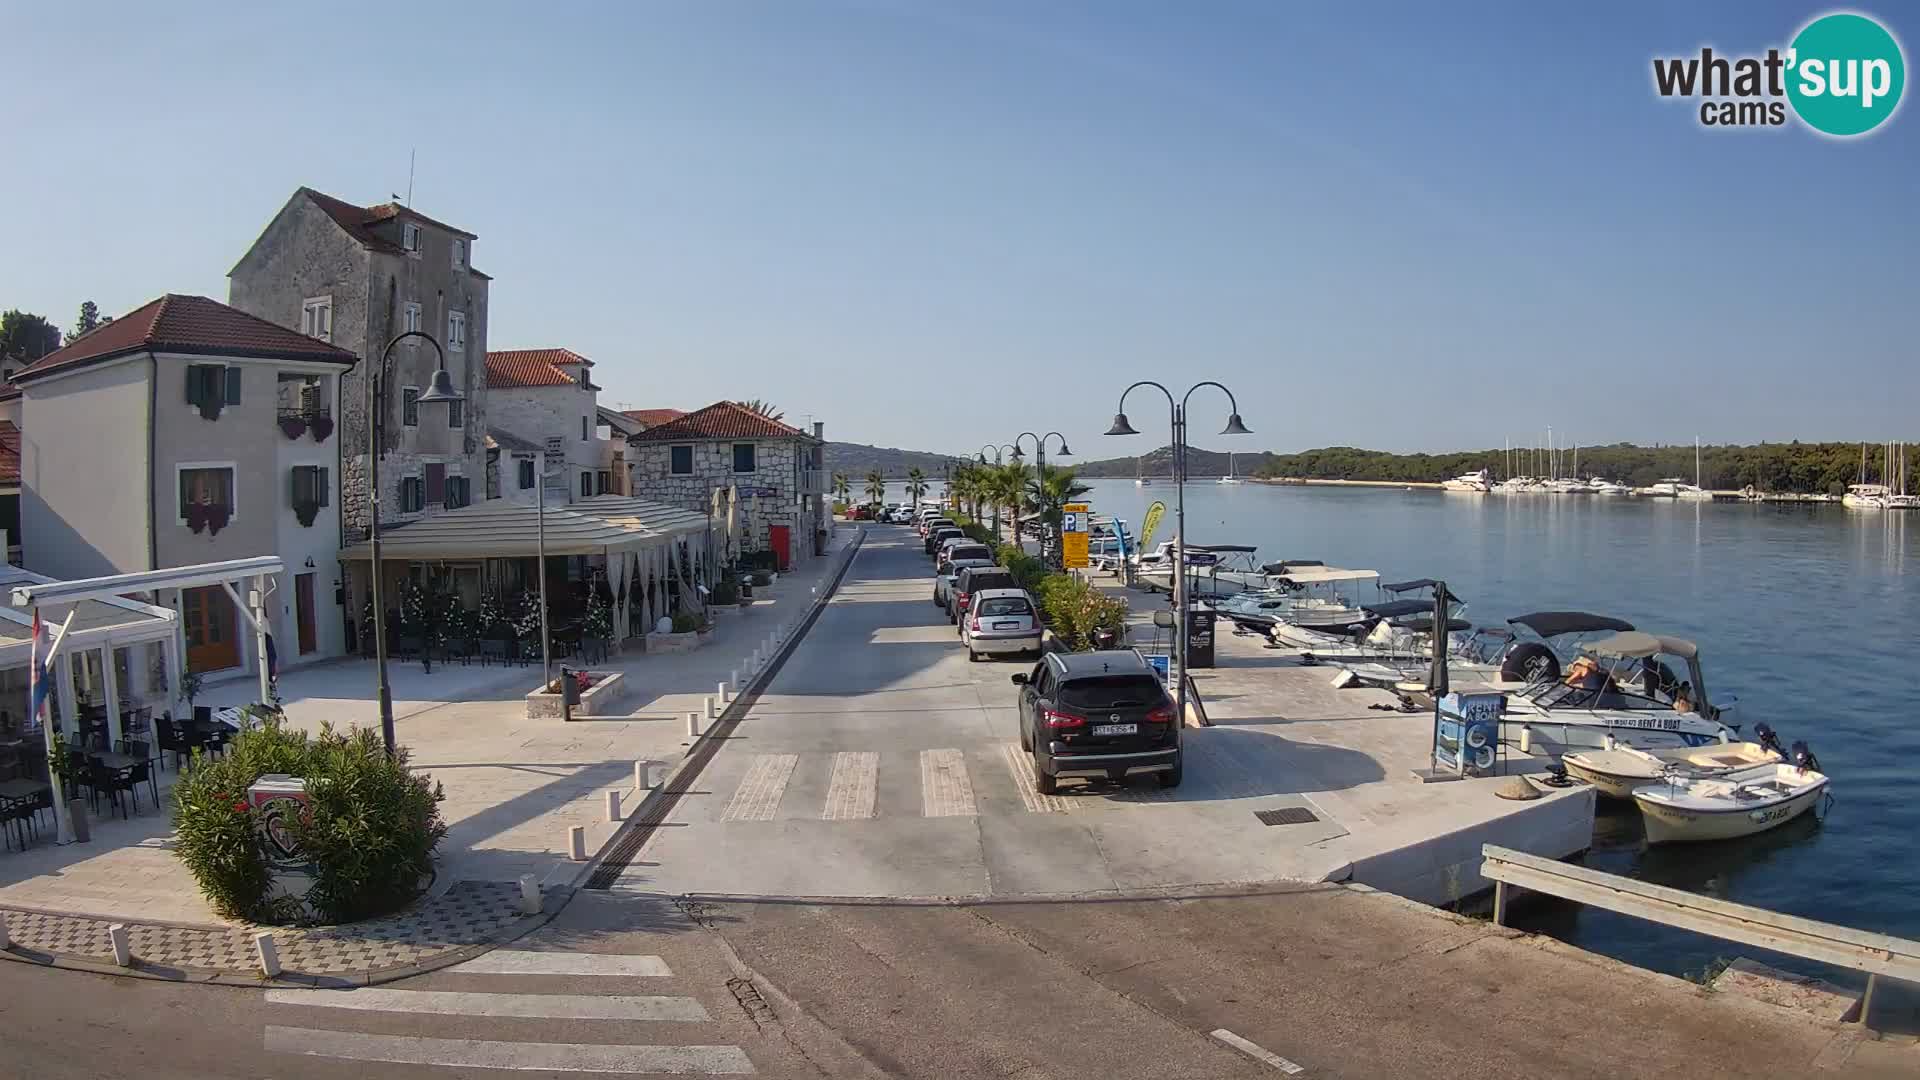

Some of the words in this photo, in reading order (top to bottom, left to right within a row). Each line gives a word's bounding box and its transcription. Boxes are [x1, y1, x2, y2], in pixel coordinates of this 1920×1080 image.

[1065, 514, 1076, 531] P
[1467, 703, 1499, 713] RENT
[1466, 712, 1474, 721] A
[1475, 711, 1498, 721] BOAT
[1637, 718, 1657, 729] RENT
